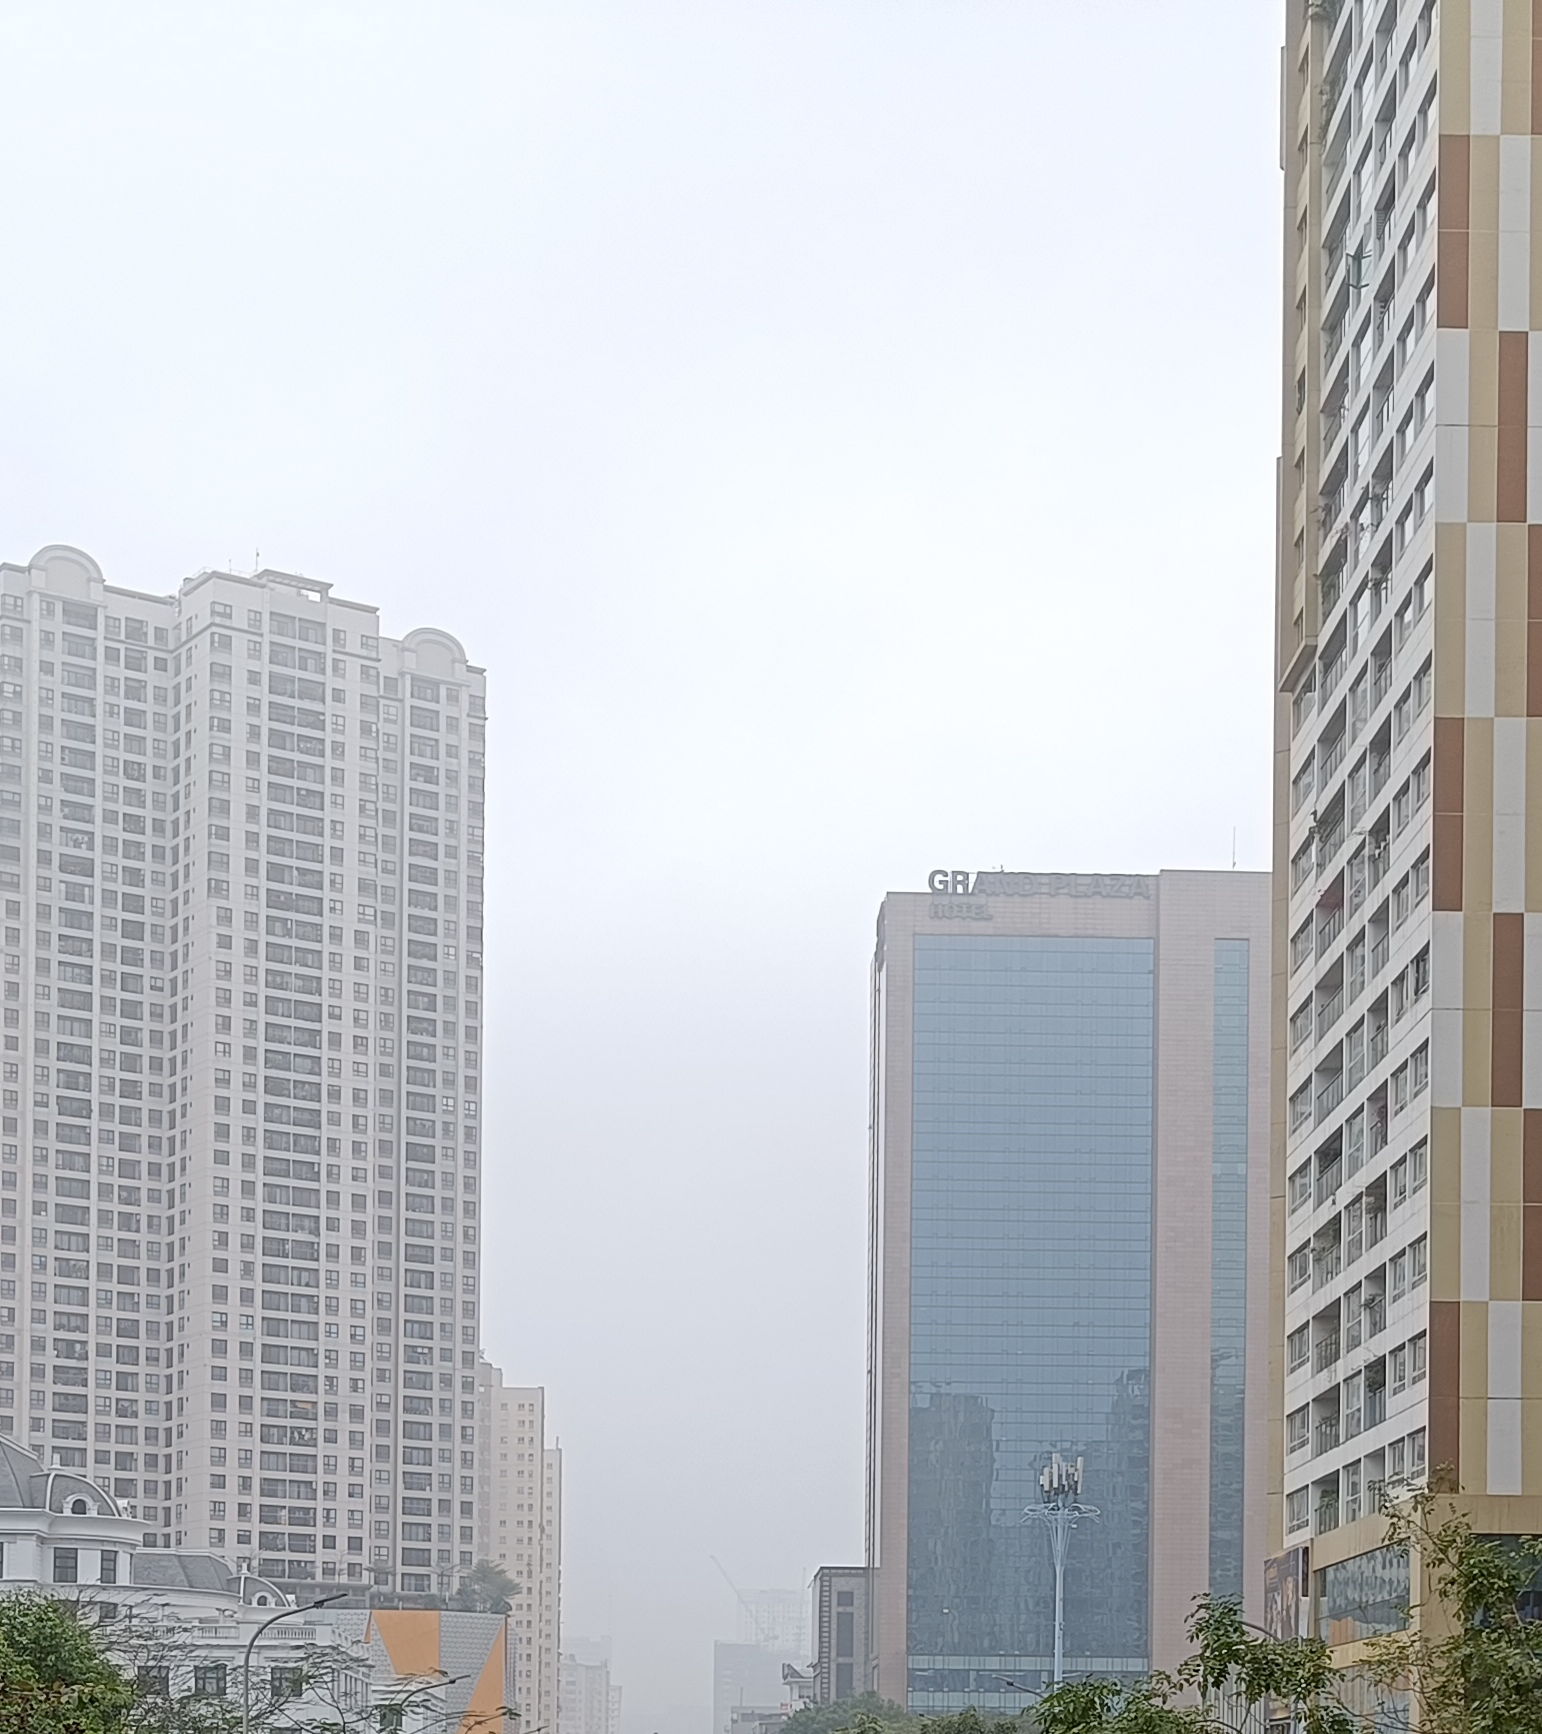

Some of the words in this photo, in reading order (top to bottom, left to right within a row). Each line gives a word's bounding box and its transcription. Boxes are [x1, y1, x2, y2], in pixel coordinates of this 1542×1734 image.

[928, 869, 1036, 896] GRAND
[1049, 873, 1150, 898] PLAZA
[929, 903, 992, 920] HOTEL
